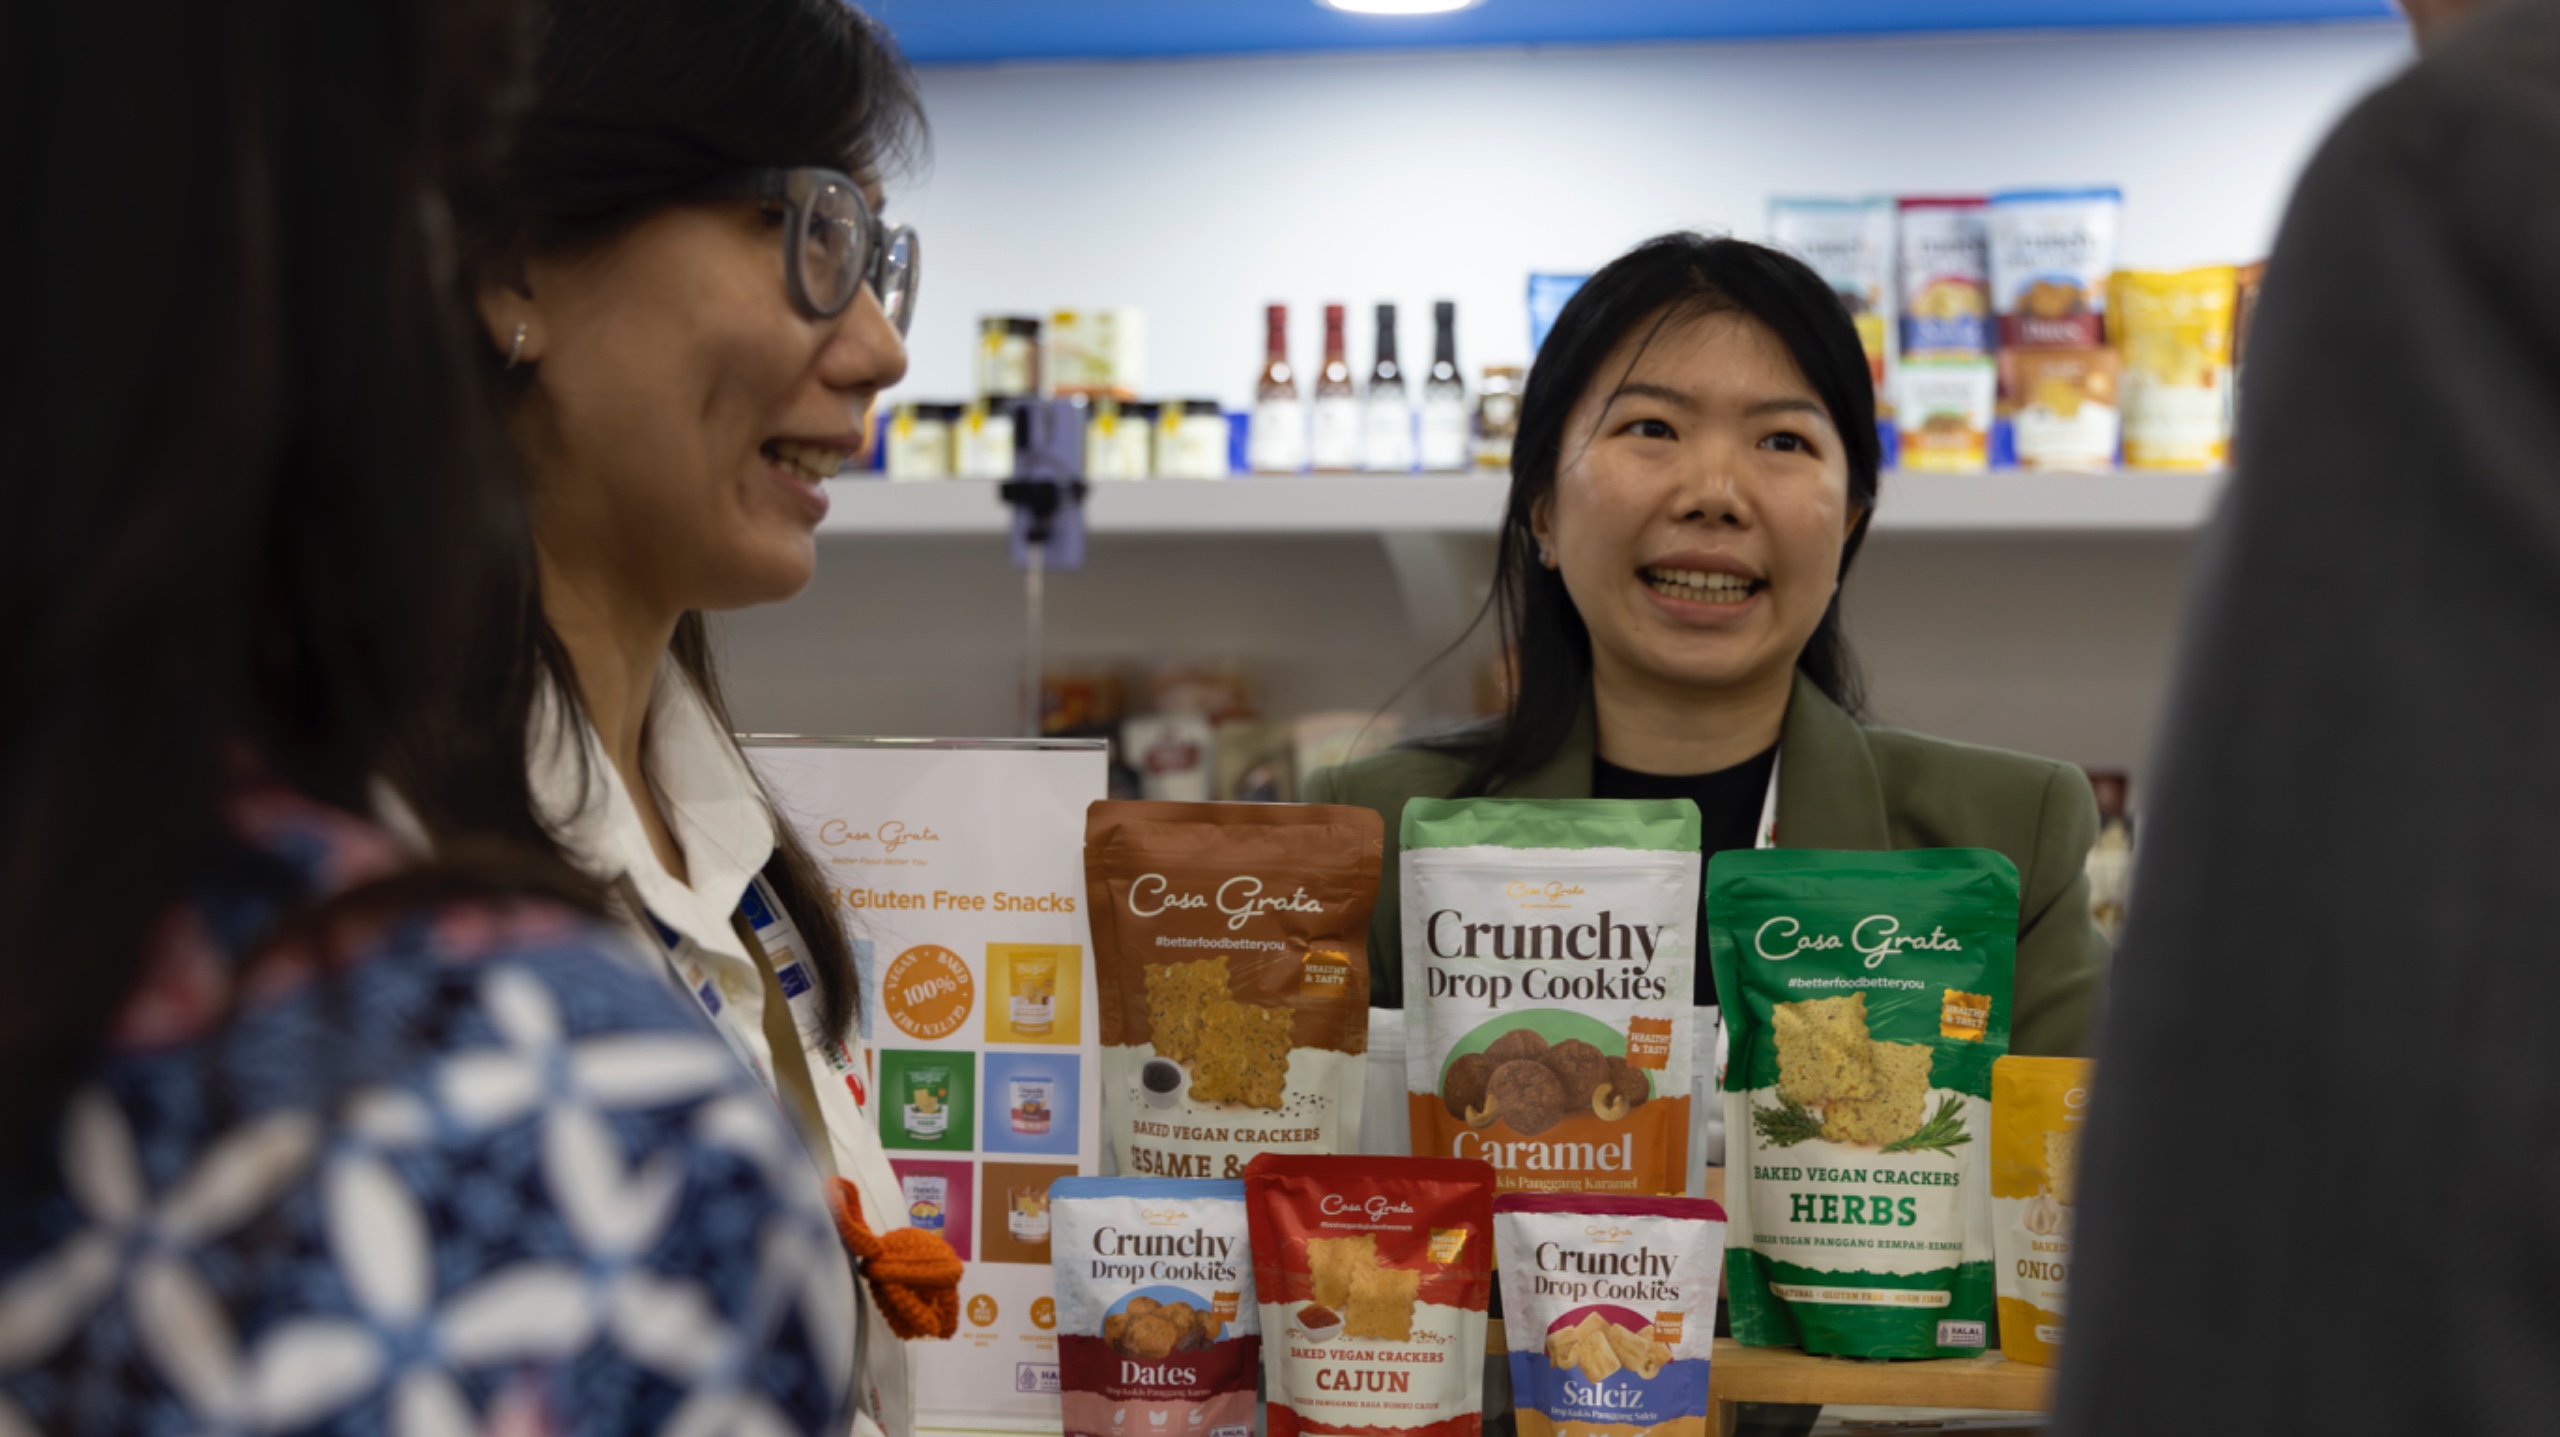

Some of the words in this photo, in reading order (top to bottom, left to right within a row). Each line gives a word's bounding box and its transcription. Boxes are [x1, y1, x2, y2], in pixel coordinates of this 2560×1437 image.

[819, 819, 871, 847] Casa
[877, 820, 940, 853] Grata
[859, 856, 881, 865] Food
[883, 857, 908, 866] Better
[912, 858, 928, 867] You
[849, 888, 925, 910] Gluten
[933, 890, 985, 911] Free
[993, 892, 1076, 913] Snacks
[1128, 873, 1208, 917] Casa
[1216, 875, 1324, 930] Grata
[1506, 880, 1541, 899] Casa
[1544, 880, 1585, 902] Grata
[1155, 935, 1286, 951] #betterfoodbetteryou
[1427, 909, 1664, 975] Crunchy
[1755, 916, 1843, 961] Casa
[1852, 914, 1962, 969] Grata
[887, 952, 917, 989] VEGAN
[937, 951, 969, 985] BAKED
[903, 974, 957, 1007] 100%
[1427, 967, 1513, 1008] Drop
[1521, 967, 1666, 1000] Cookies
[1788, 977, 1925, 990] #betterfoodbetteryou
[893, 1008, 920, 1034] FREE
[921, 1004, 967, 1036] GLUTEN
[1630, 1032, 1672, 1044] HEALTHY
[1631, 1044, 1640, 1053] &
[1643, 1045, 1669, 1055] TASTY
[1133, 1120, 1170, 1138] BAKED
[1173, 1125, 1229, 1142] VEGAN
[1234, 1127, 1320, 1144] CRACKERS
[1453, 1131, 1633, 1170] Caramel
[1496, 1176, 1516, 1188] kis
[1519, 1176, 1582, 1191] Panggang
[1584, 1176, 1638, 1189] Karamel
[1754, 1166, 1802, 1182] BAKED
[1806, 1167, 1867, 1183] VEGAN
[1872, 1169, 1960, 1187] CRACKERS
[1320, 1193, 1362, 1215] Casa
[1364, 1195, 1415, 1222] Grata
[1789, 1194, 1917, 1227] HERBS
[1093, 1225, 1236, 1264] Crunchy
[1813, 1236, 1874, 1249] PANGGANG
[2031, 1240, 2069, 1253] BAKED
[1091, 1260, 1145, 1285] Drop
[1151, 1261, 1236, 1281] Cookies
[1536, 1242, 1679, 1283] Crunchy
[1534, 1275, 1587, 1302] Drop
[1593, 1278, 1680, 1300] Cookies
[1822, 1291, 1859, 1301] GLUTEN
[1291, 1347, 1326, 1359] BAKED
[1330, 1349, 1374, 1362] VEGAN
[1378, 1350, 1444, 1363] CRACKERS
[1120, 1360, 1197, 1386] Dates
[1316, 1369, 1411, 1393] CAJUN
[1562, 1380, 1644, 1409] Salciz
